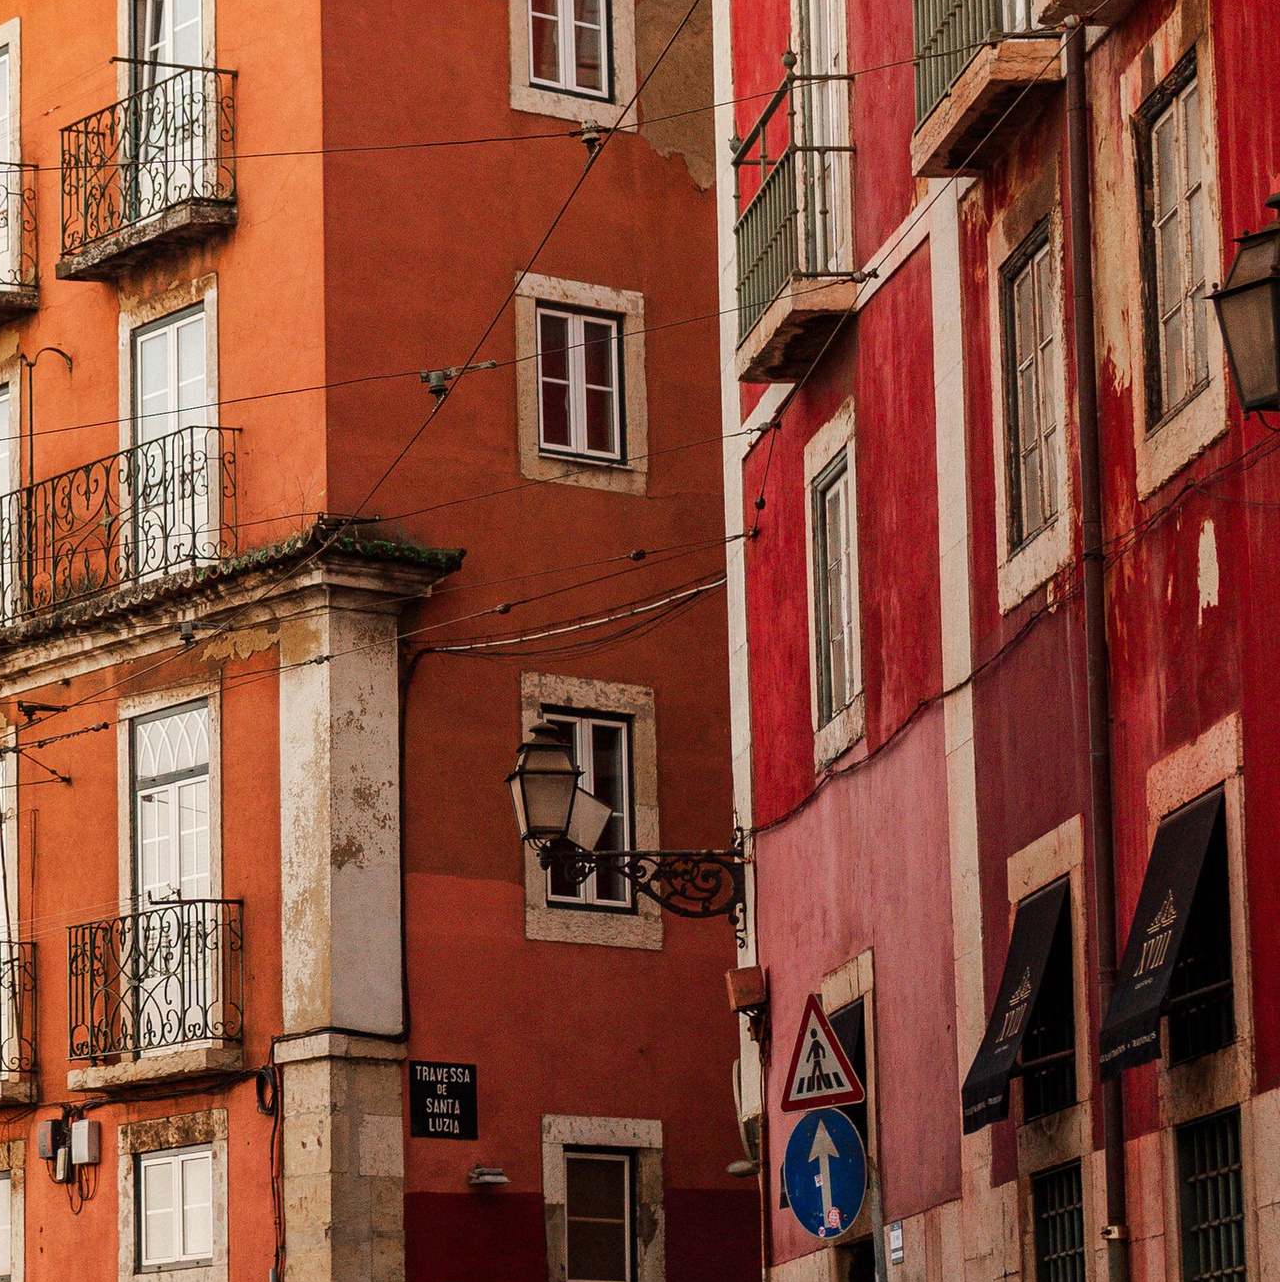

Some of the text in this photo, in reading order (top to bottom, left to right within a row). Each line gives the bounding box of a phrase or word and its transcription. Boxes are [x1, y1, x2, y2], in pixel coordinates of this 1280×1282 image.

[415, 1065, 470, 1083] TRAVESSA
[437, 1084, 447, 1095] DE
[426, 1097, 460, 1114] SANTA
[428, 1118, 460, 1134] LUZIA
